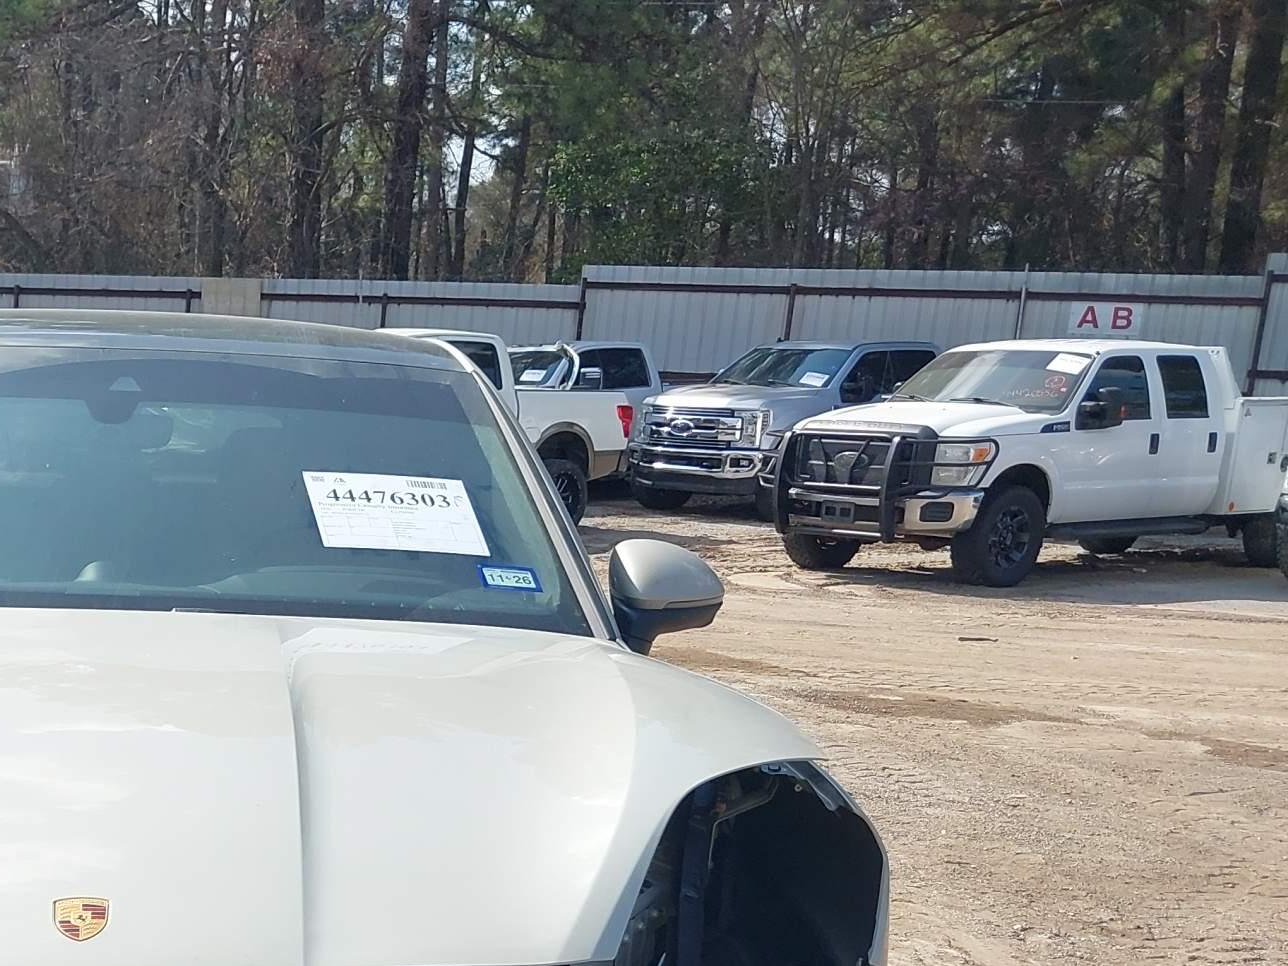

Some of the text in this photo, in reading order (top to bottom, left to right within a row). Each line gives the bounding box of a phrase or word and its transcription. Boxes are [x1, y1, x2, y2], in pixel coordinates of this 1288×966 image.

[1076, 305, 1133, 330] A B
[326, 488, 451, 508] 44476303
